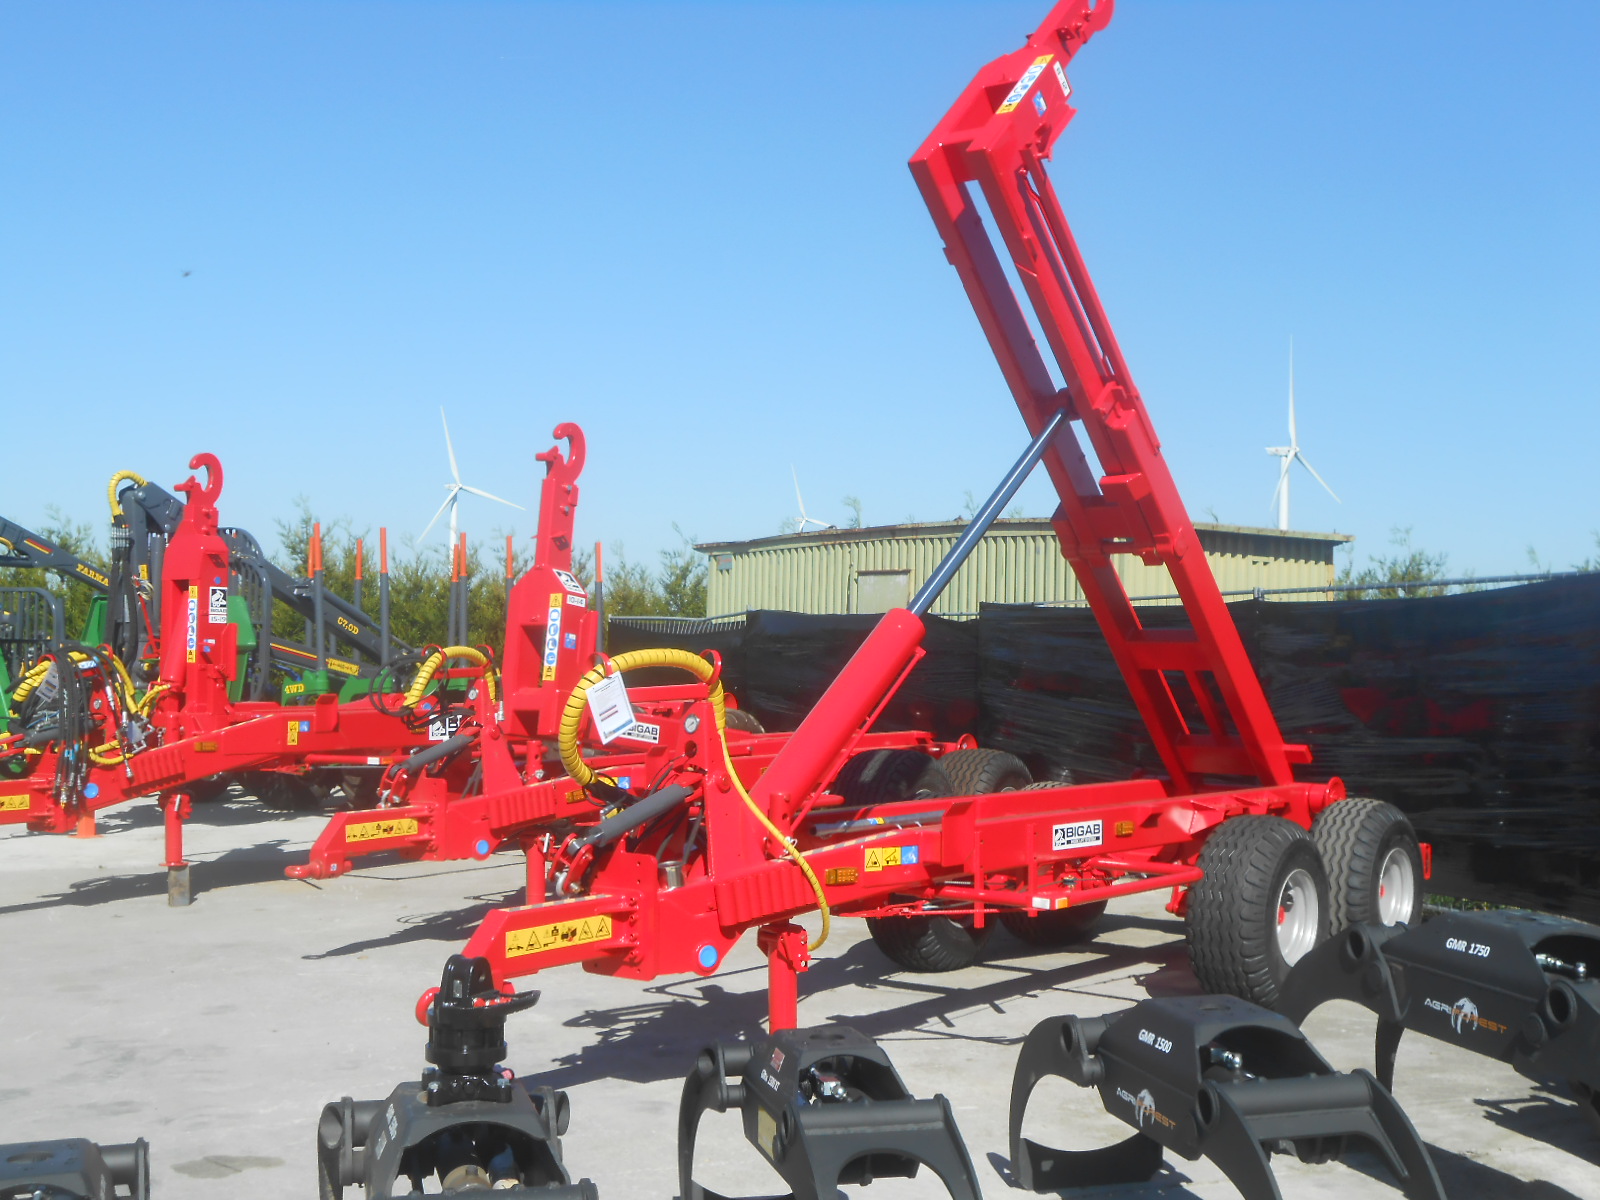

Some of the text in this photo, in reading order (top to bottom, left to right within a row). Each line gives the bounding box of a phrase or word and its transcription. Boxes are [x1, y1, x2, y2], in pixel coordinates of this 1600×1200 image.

[75, 563, 109, 587] FARMA
[284, 683, 305, 694] 4WD
[1066, 824, 1101, 838] BIGAB
[1446, 937, 1491, 957] GMR 1750
[1154, 1036, 1173, 1054] 1500
